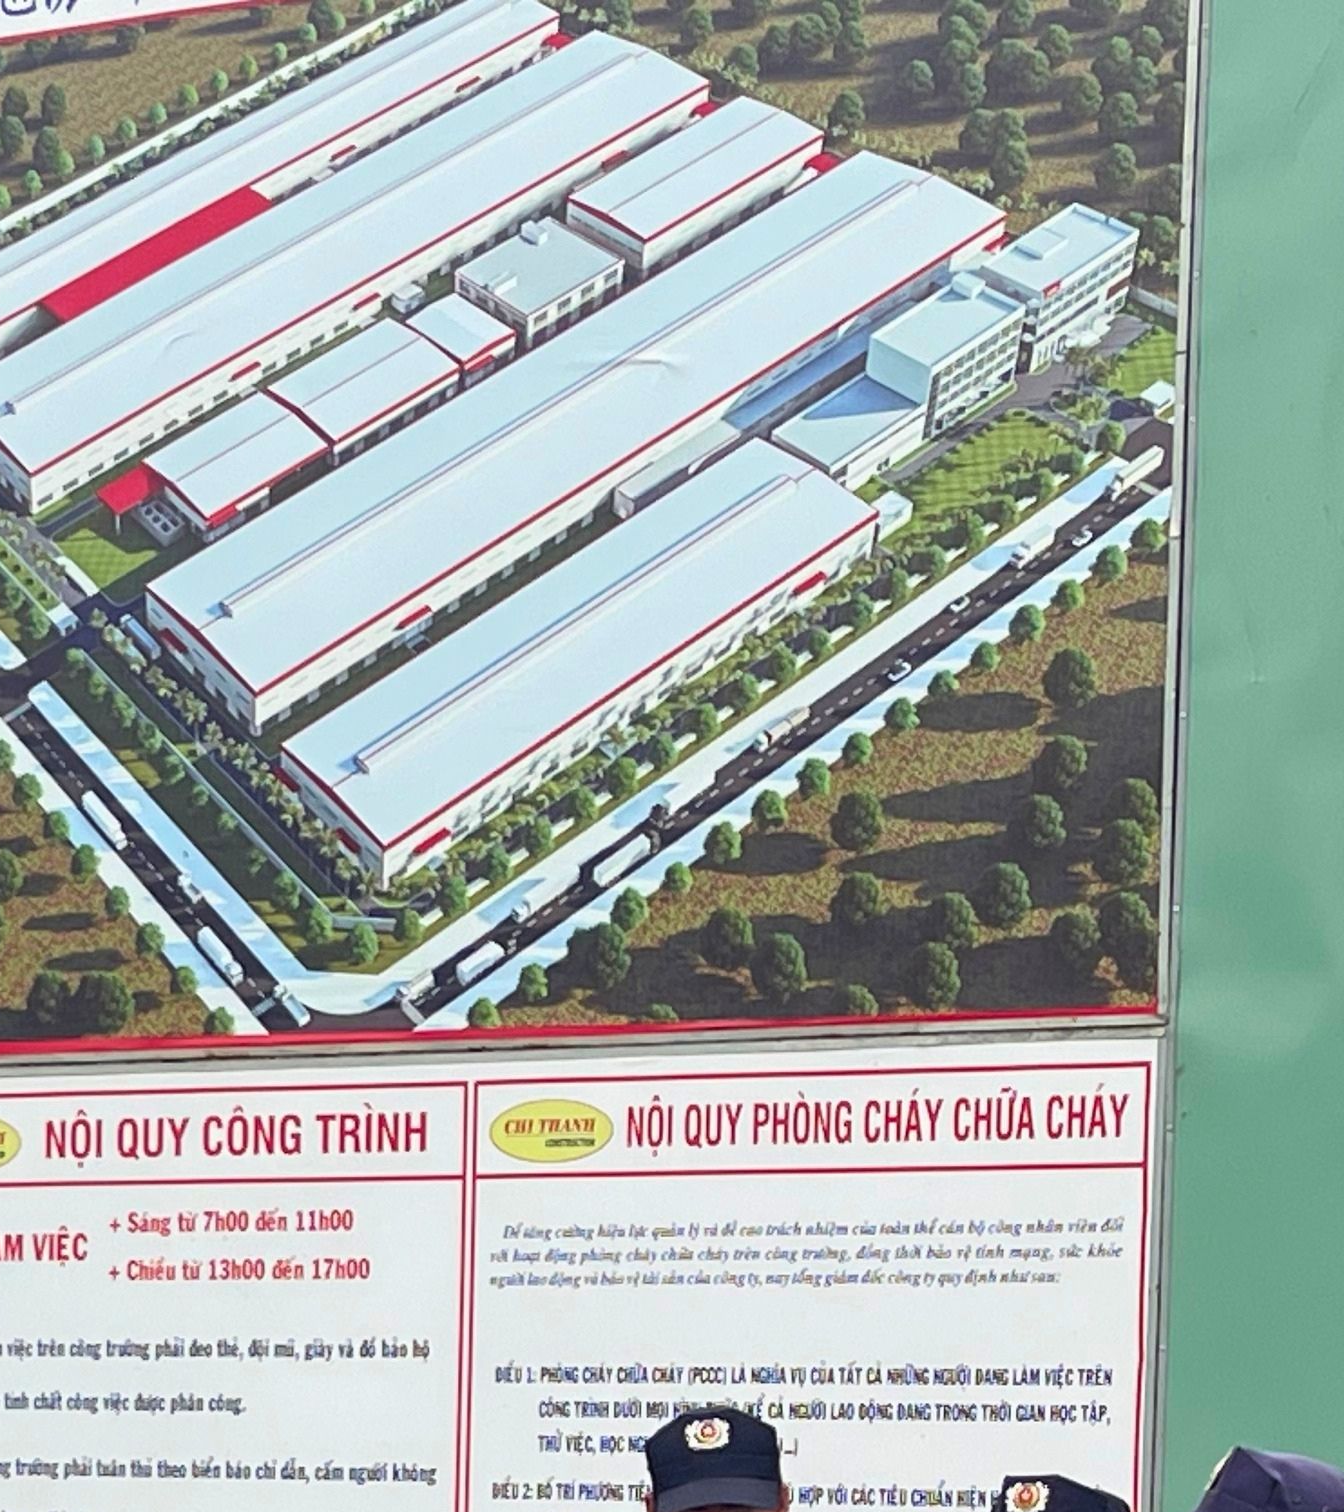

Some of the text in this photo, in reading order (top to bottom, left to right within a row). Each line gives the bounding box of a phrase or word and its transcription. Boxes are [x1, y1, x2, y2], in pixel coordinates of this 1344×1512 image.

[45, 1102, 428, 1168] NỘI QUY CÔNG TRÌNH
[626, 1083, 1130, 1157] NỘI QUY PHÒNG CHÁY CHỮA CHÁY
[127, 1209, 354, 1236] Sáng từ 7h00 đến 11h00
[32, 1225, 88, 1268] VIỆC
[126, 1256, 371, 1283] Chiều từ 13h00 đến 17h00
